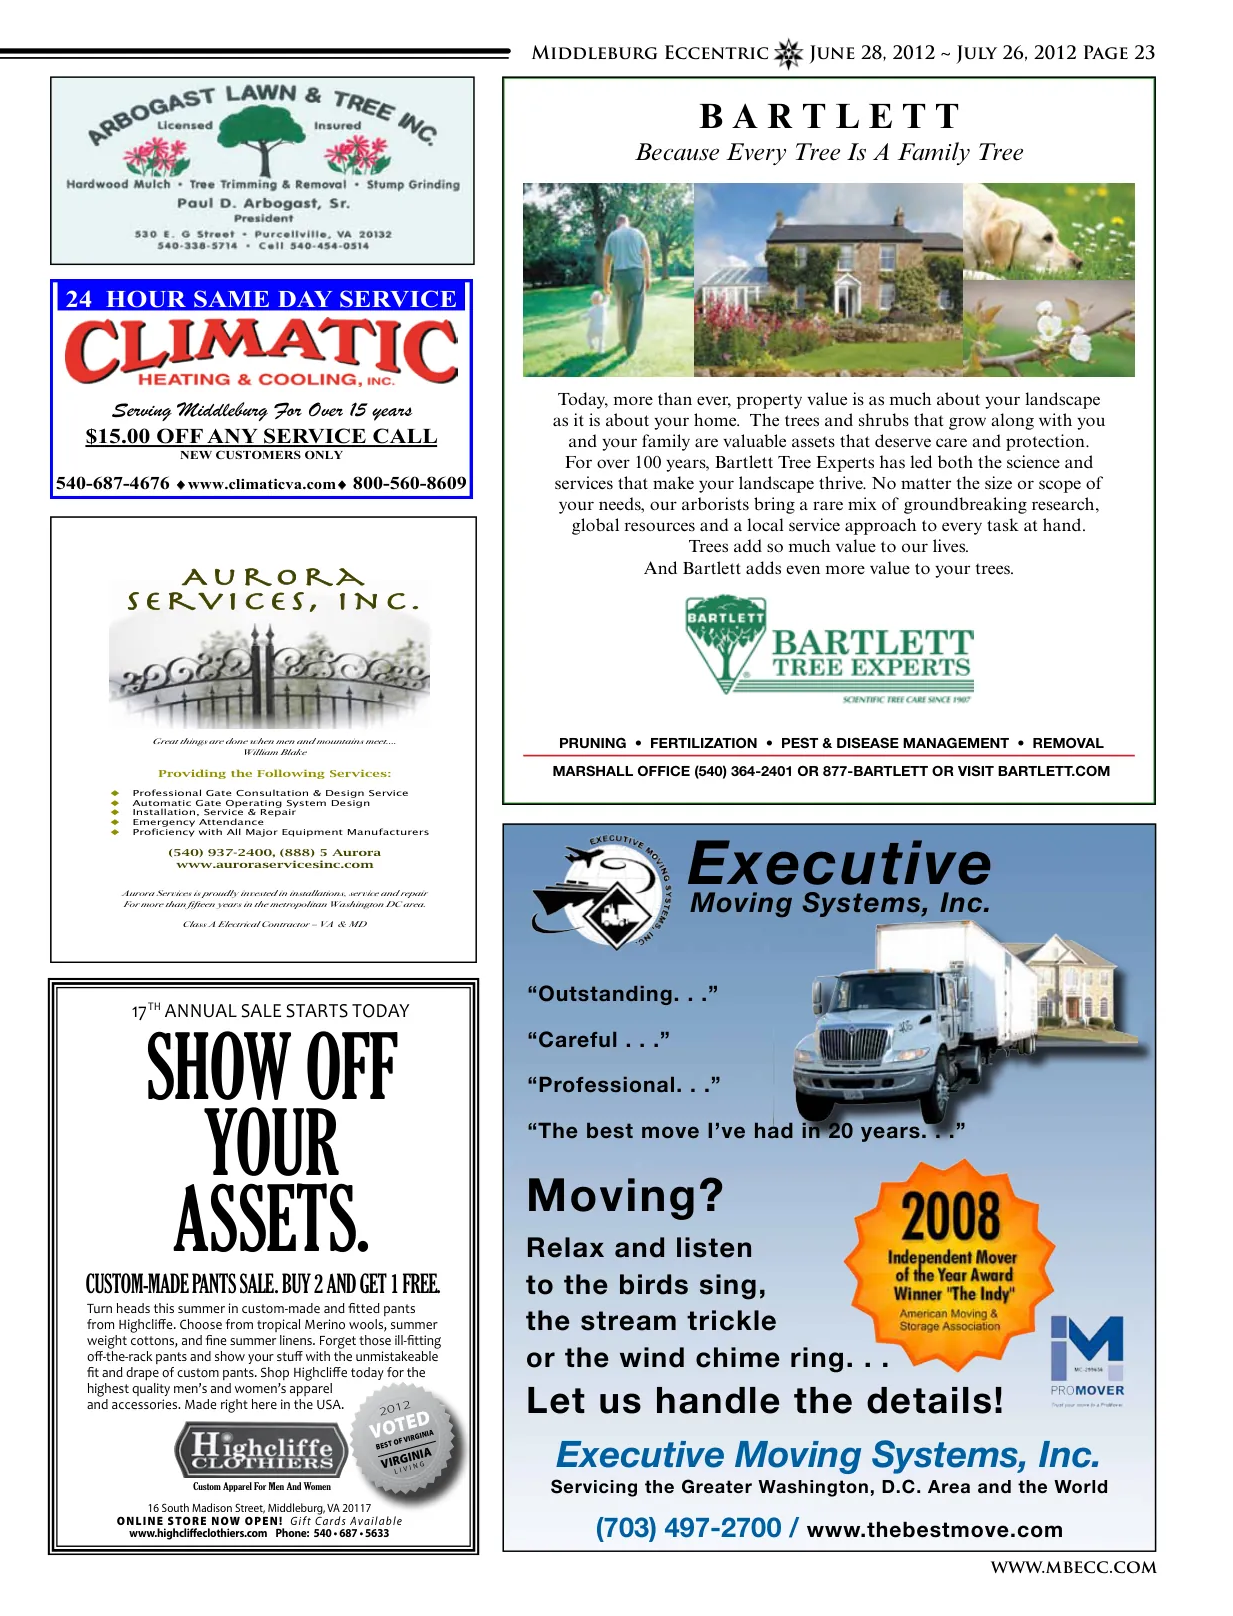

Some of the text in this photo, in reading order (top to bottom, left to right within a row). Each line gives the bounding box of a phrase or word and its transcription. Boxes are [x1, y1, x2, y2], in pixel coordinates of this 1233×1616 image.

[88, 84, 437, 146] ARBOGAST LAWN & TREE INC.
[699, 104, 958, 128] BARTLETT
[158, 120, 213, 130] Licensed
[314, 121, 361, 130] Insured
[635, 142, 1023, 164] Because Every Tree Is A Family Tree
[178, 198, 350, 211] Paul D. Arbogast, Sr.
[234, 214, 294, 223] President
[157, 241, 369, 251] 540-338-5714 Cell 540-454-0514
[66, 290, 456, 308] 24 HOUR SAME DAY SERVICE
[65, 317, 458, 383] CLIMATIC
[139, 373, 395, 388] HEATING & COOLING, INC.
[56, 477, 170, 489] 540-687-4676
[188, 479, 335, 489] www.climaticva.com
[353, 476, 466, 489] 800-560-8609
[182, 568, 365, 586] AURORA
[128, 592, 418, 612] SERVICES, INC.
[687, 612, 764, 624] BARTLETT
[772, 630, 974, 655] BARTLETT
[773, 658, 970, 676] TREE EXPERTS
[560, 738, 626, 748] PRUNING
[651, 738, 757, 748] FERTILIZATION
[782, 738, 1009, 748] PEST & DISEASE MANAGEMENT
[1033, 738, 1104, 748] REMOVAL
[159, 769, 391, 779] Providing the Following Services:
[133, 818, 264, 828] Emergency Attendance
[176, 860, 374, 868] www.auroraservicesinc.com
[688, 840, 991, 885] Executive
[590, 835, 672, 945] EXECUTIVE MOVING SYSTEMS, INC.
[690, 892, 989, 918] Moving Systems, Inc.
[148, 1031, 398, 1100] SHOW OFF
[204, 1107, 339, 1176] YOUR
[529, 1177, 722, 1220] Moving?
[173, 1183, 368, 1252] ASSETS.
[902, 1191, 1000, 1241] 2008
[1051, 1386, 1124, 1395] PROMOVER
[380, 1400, 411, 1416] 2012
[369, 1411, 430, 1438] VOTED
[192, 1432, 333, 1461] Highcliffe
[192, 1457, 333, 1469] CLOTHIERS
[597, 1517, 781, 1542] (703) 497-2700
[807, 1522, 1062, 1537] www.thebestmove.com
